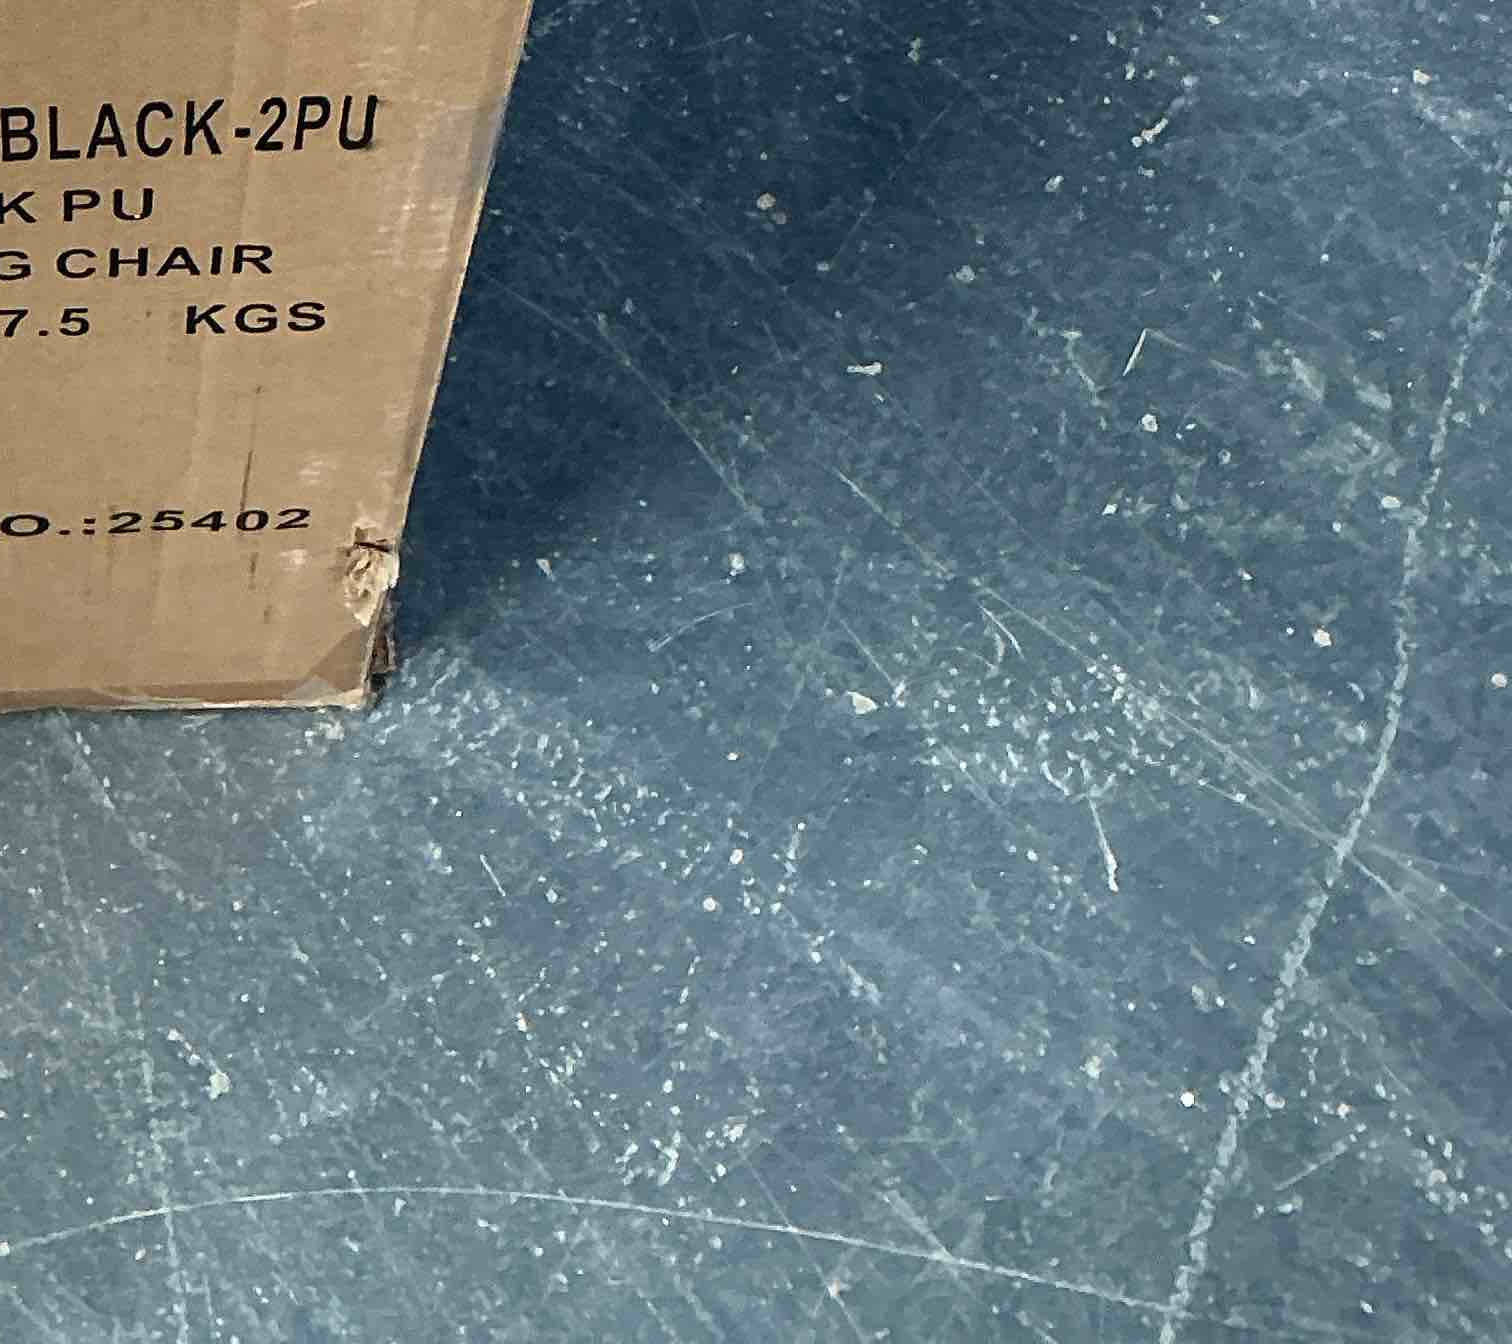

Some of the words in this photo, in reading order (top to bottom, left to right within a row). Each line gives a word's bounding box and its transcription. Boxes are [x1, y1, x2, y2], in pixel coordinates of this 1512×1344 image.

[0, 94, 378, 163] BLACK-2PU
[62, 187, 155, 222] PU
[56, 244, 273, 279] CHAIR
[185, 301, 326, 335] KGS
